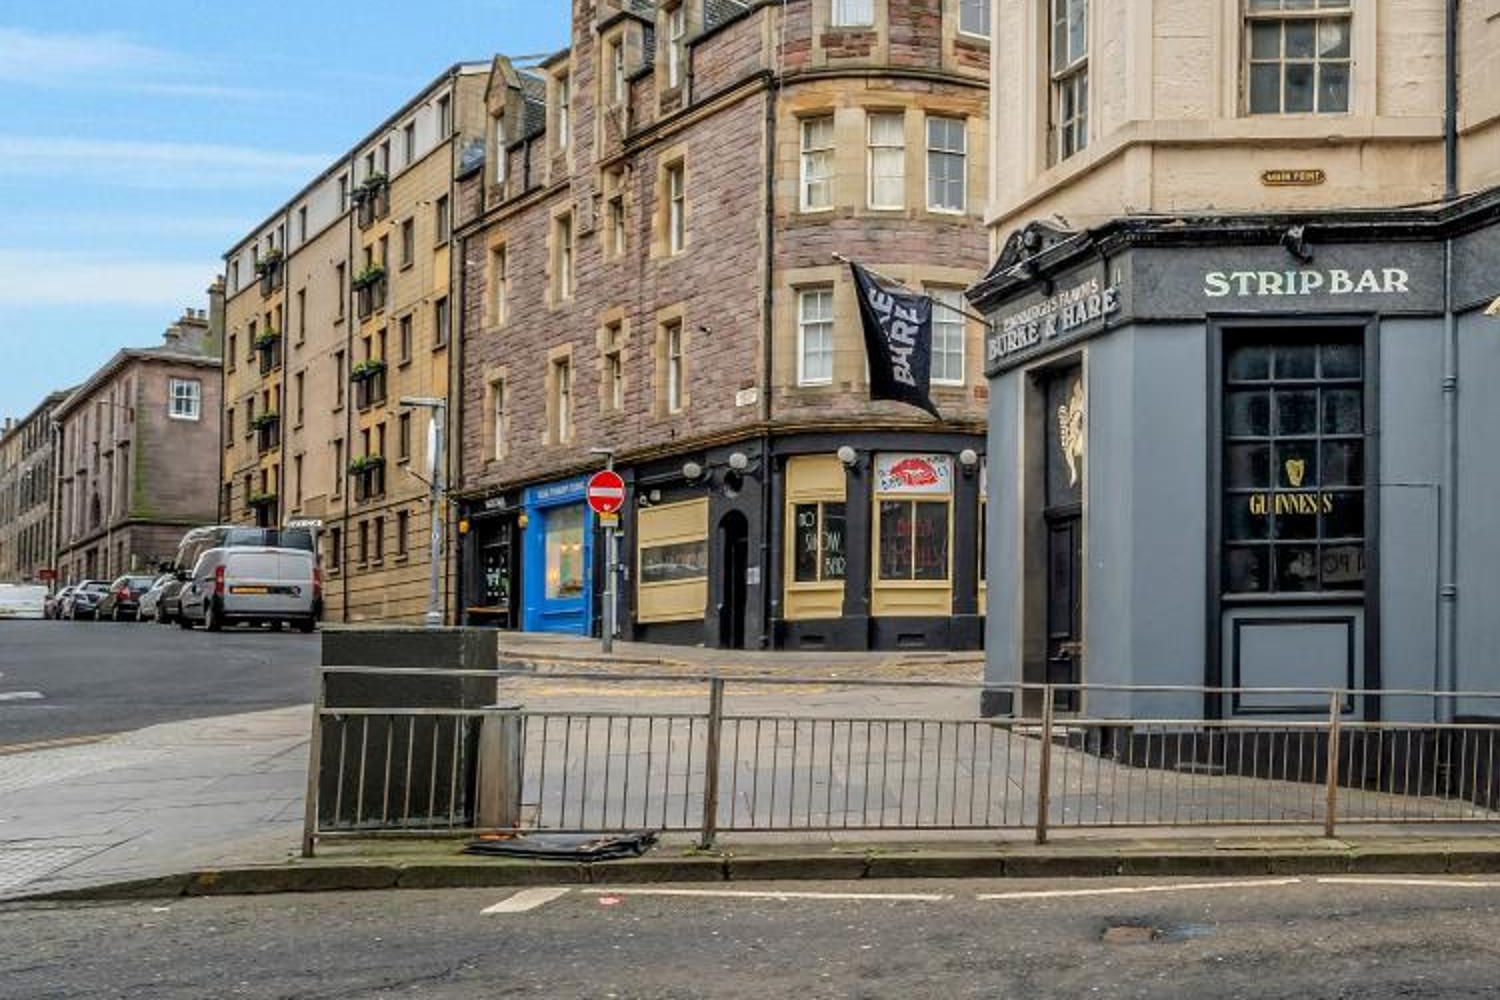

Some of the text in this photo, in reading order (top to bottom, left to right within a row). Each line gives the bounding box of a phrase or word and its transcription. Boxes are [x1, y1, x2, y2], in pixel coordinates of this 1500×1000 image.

[1203, 268, 1409, 297] STRIP BAR
[988, 322, 1040, 360] BURKE
[1062, 285, 1119, 331] HARE
[1249, 492, 1334, 515] GUINNESS
